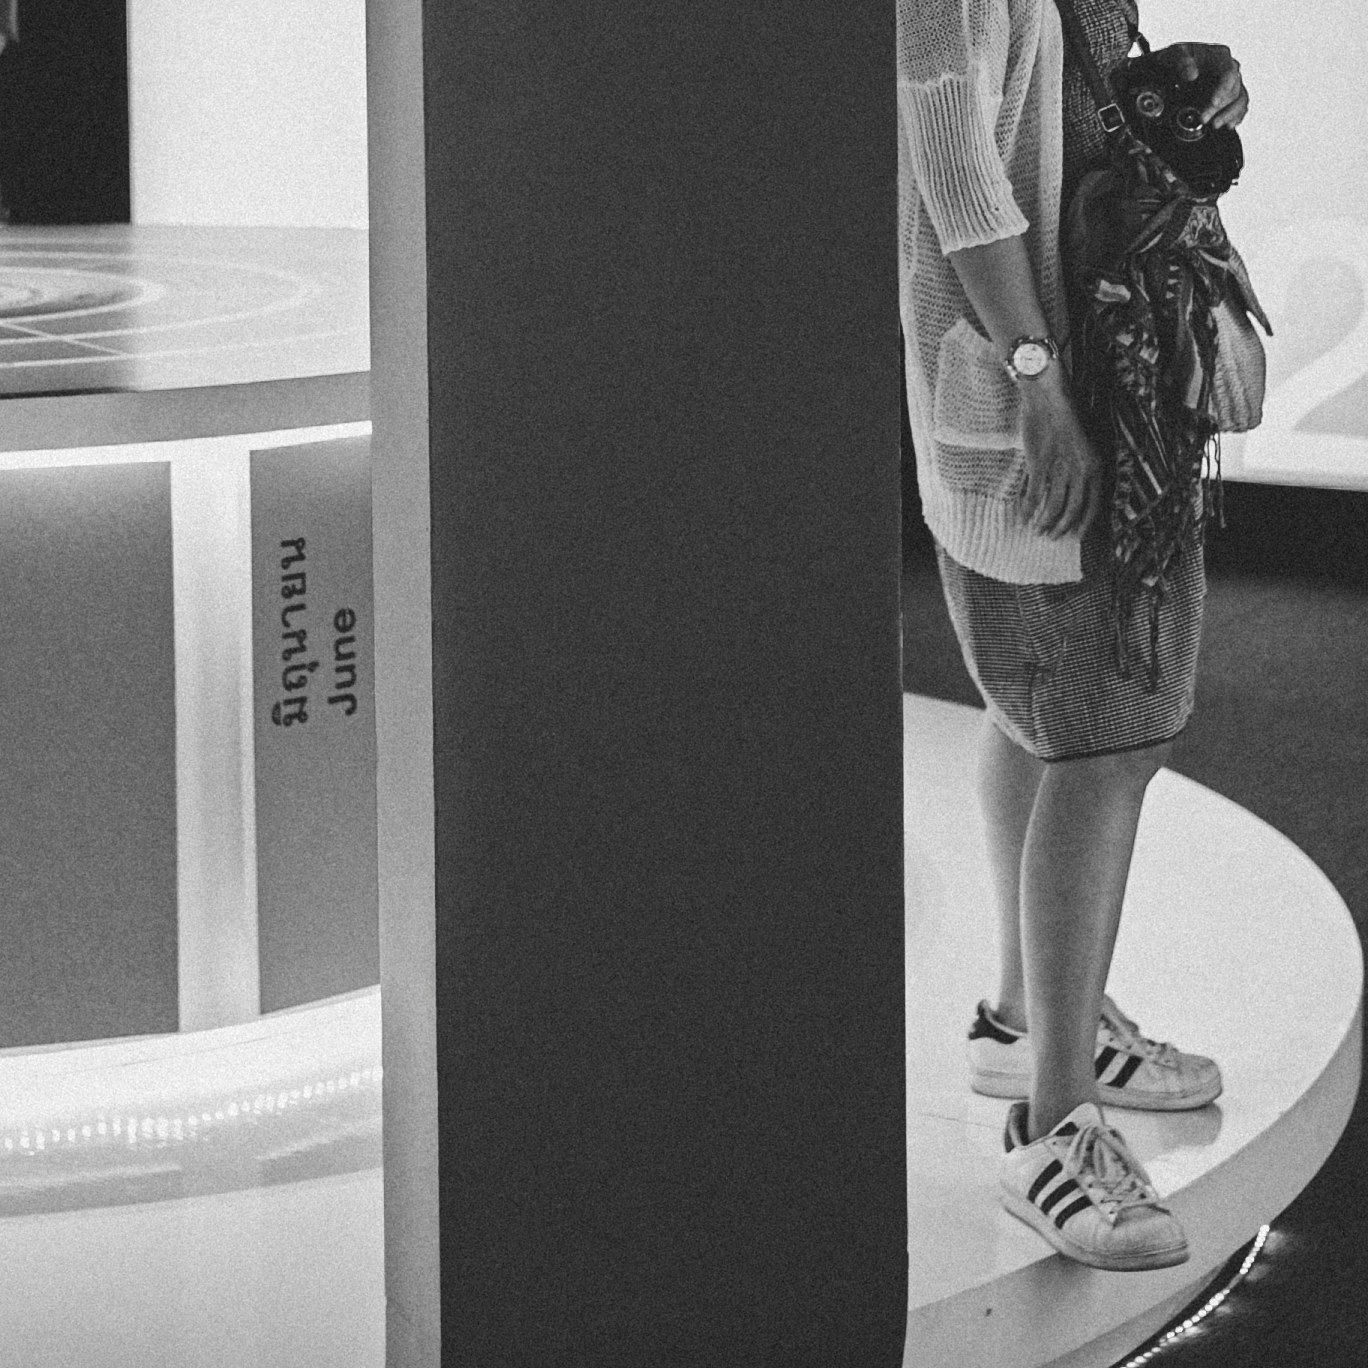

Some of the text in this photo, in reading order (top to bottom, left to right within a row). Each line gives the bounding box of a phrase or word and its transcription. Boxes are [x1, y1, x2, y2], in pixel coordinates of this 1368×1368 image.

[271, 536, 320, 727] มิถุนายน
[327, 607, 358, 716] June
